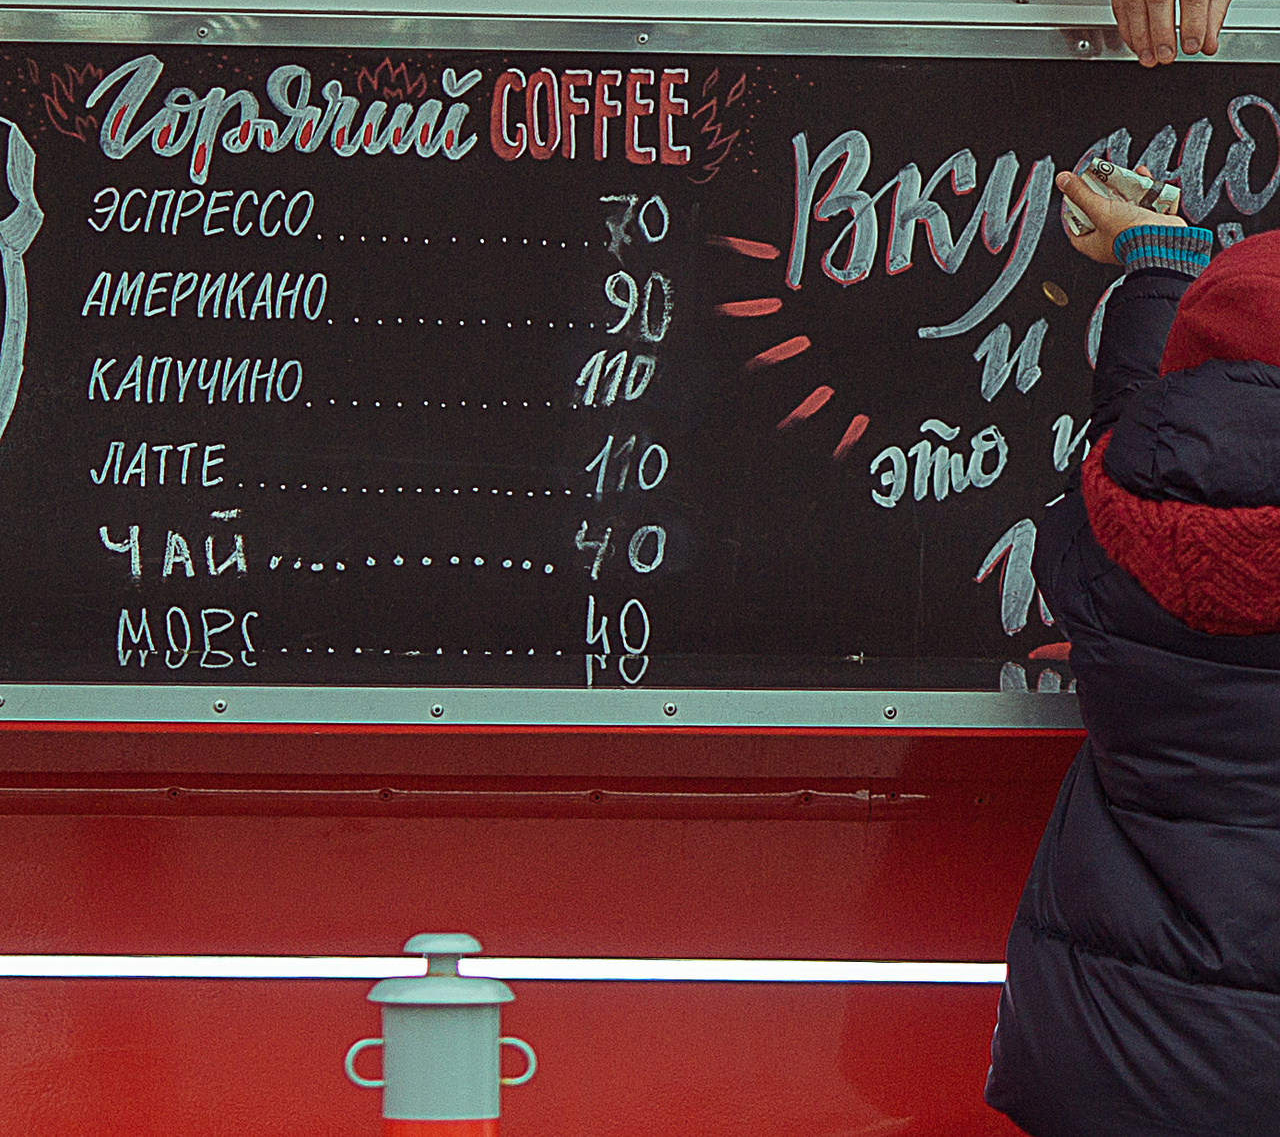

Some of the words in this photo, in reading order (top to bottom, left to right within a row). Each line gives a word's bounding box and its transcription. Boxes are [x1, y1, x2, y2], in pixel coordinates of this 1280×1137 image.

[86, 54, 482, 185] Горячий
[490, 67, 692, 164] COFFEE
[87, 187, 315, 238] ЭСПРЕССО
[599, 194, 669, 264] 70
[81, 271, 328, 320] АМЕРИКАНО
[605, 270, 674, 342] 90
[88, 355, 303, 404] КАПУЧИНО
[575, 349, 656, 407] 110
[90, 441, 226, 487] ЛАТТЕ
[585, 434, 668, 497] 110
[99, 508, 248, 580] ЧАЙ
[574, 520, 667, 580] 40
[585, 595, 650, 655] 40
